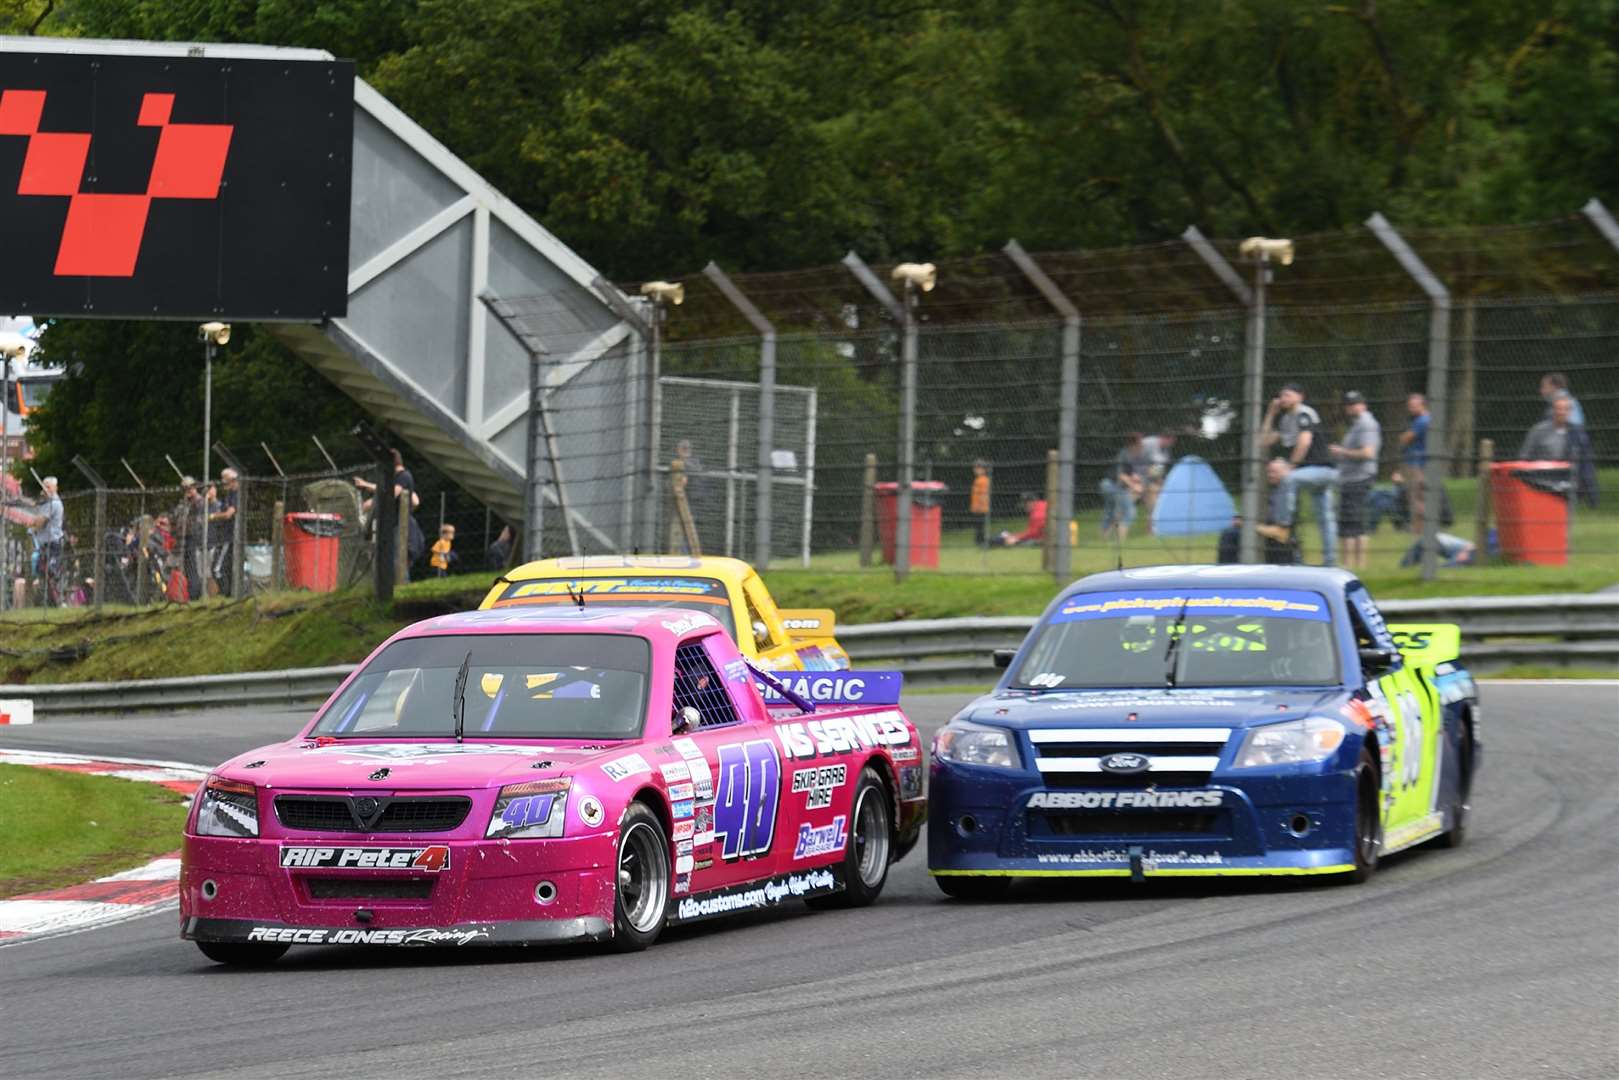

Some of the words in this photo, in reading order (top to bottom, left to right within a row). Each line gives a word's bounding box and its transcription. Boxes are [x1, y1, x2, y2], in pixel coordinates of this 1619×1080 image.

[775, 722, 816, 759] KS
[808, 711, 911, 754] SERVICES
[1107, 755, 1141, 768] Ford
[794, 769, 817, 790] SKIP
[818, 767, 845, 787] GRAB
[713, 739, 780, 859] 40
[807, 788, 832, 808] HIRE
[1026, 792, 1115, 808] ABBOT
[1116, 791, 1224, 807] FIXINGS
[501, 795, 554, 828] 40
[283, 848, 331, 867] RIP
[338, 849, 409, 868] Pete
[247, 927, 324, 944] REECE
[328, 929, 405, 945] JONES
[403, 928, 489, 945] Racing
